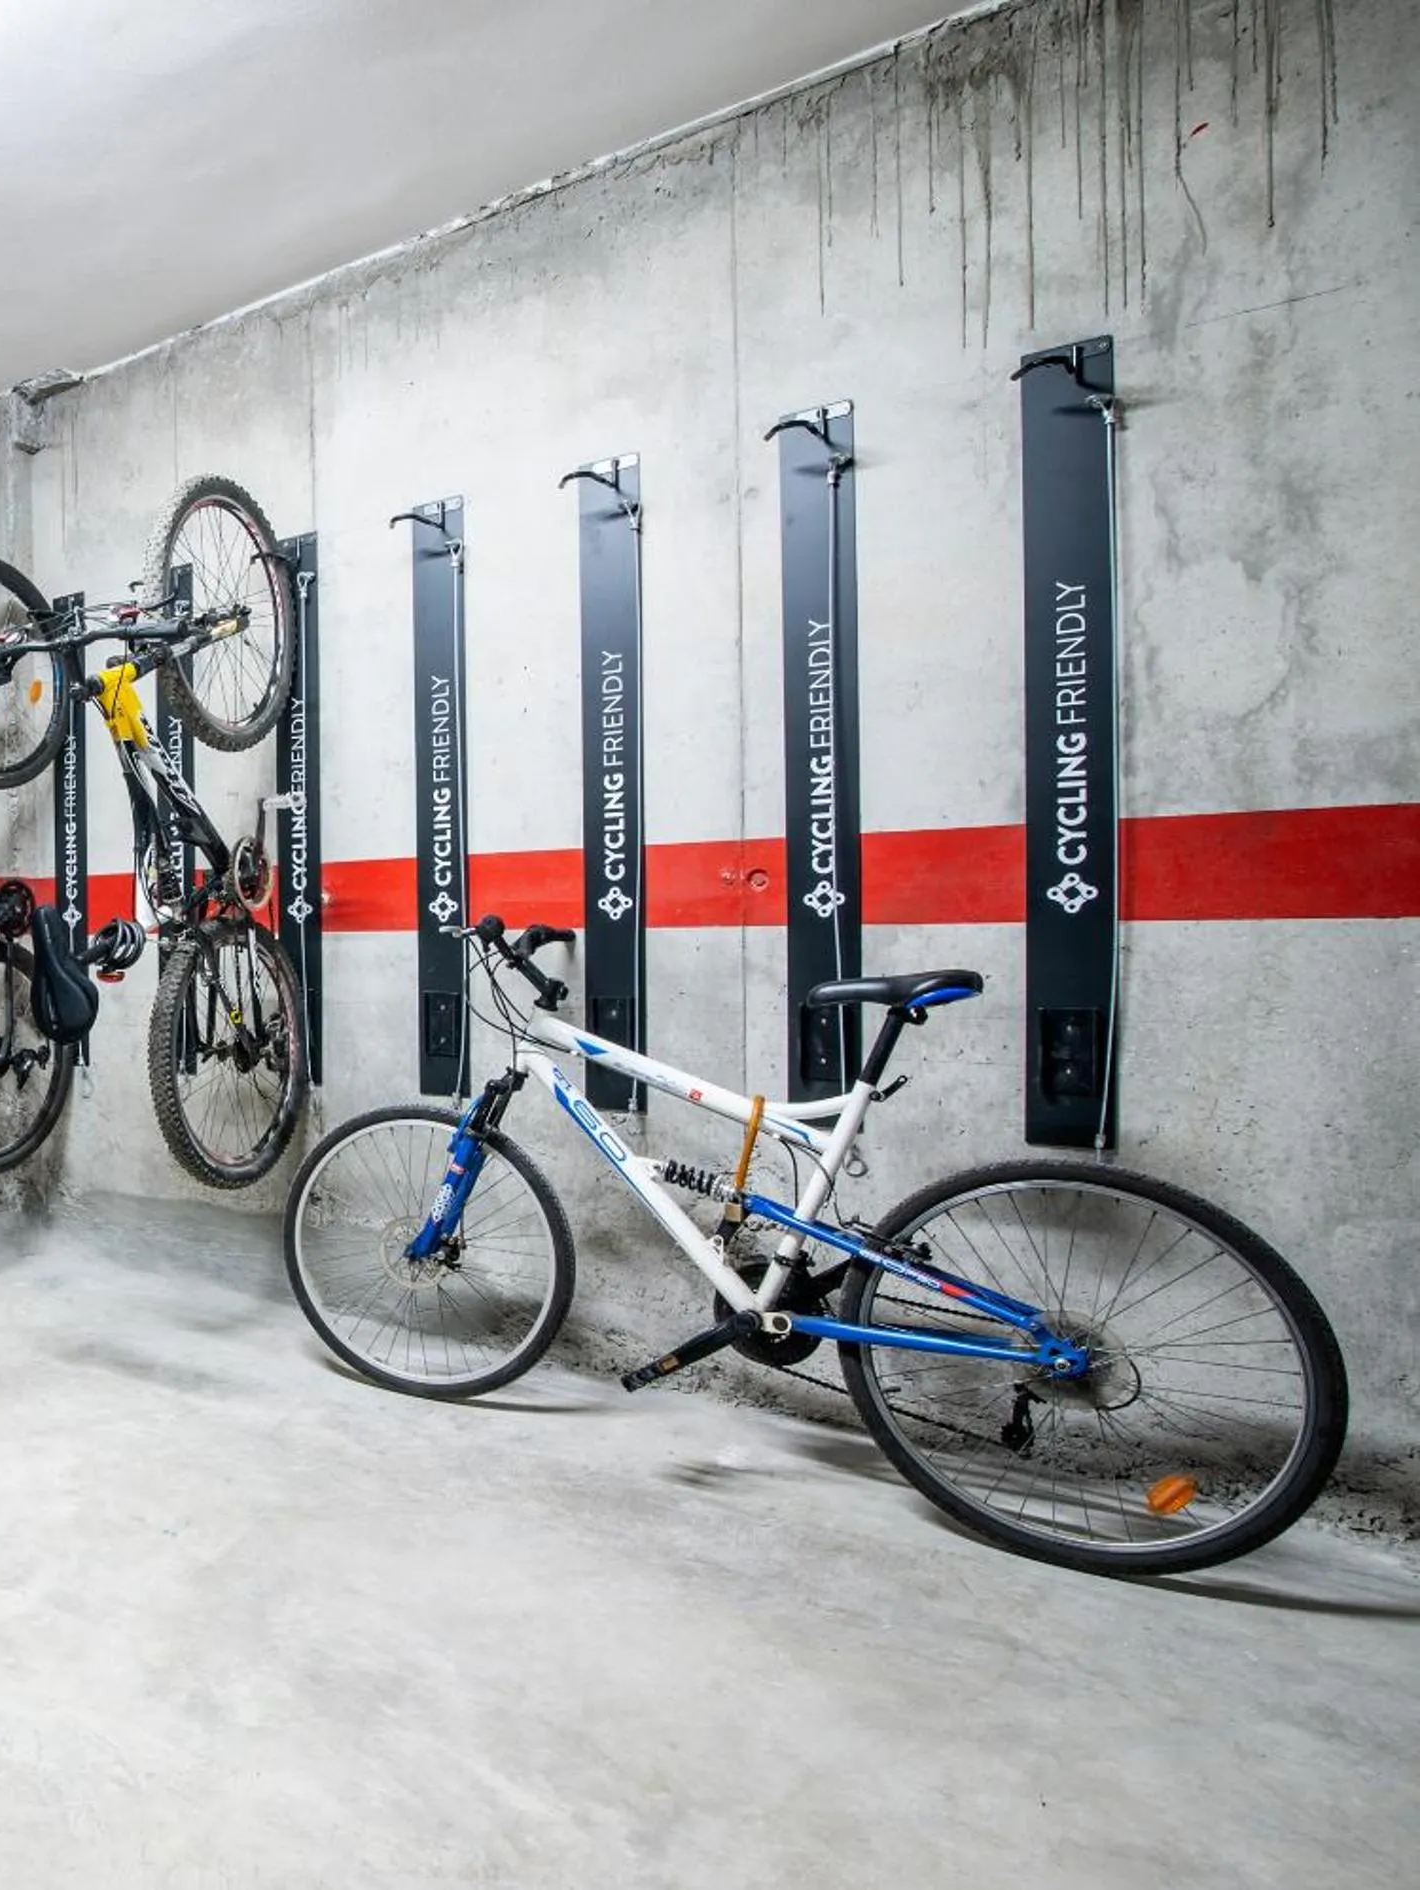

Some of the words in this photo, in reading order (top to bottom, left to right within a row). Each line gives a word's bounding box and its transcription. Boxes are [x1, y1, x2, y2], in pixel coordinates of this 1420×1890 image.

[810, 620, 833, 748] FRIENDLY
[1056, 581, 1087, 725] FRIENDLY
[291, 697, 307, 797] FRIENDLY
[431, 675, 449, 781] FRIENDLY
[602, 651, 624, 767] FRIENDLY
[63, 735, 77, 817] FRIENDLY
[604, 772, 625, 882] CYCLING
[811, 754, 834, 876] CYCLING
[1057, 734, 1087, 866] CYCLING
[65, 822, 78, 900] CYCLING
[291, 799, 308, 890] CYCLING
[433, 787, 451, 886] CYCLING
